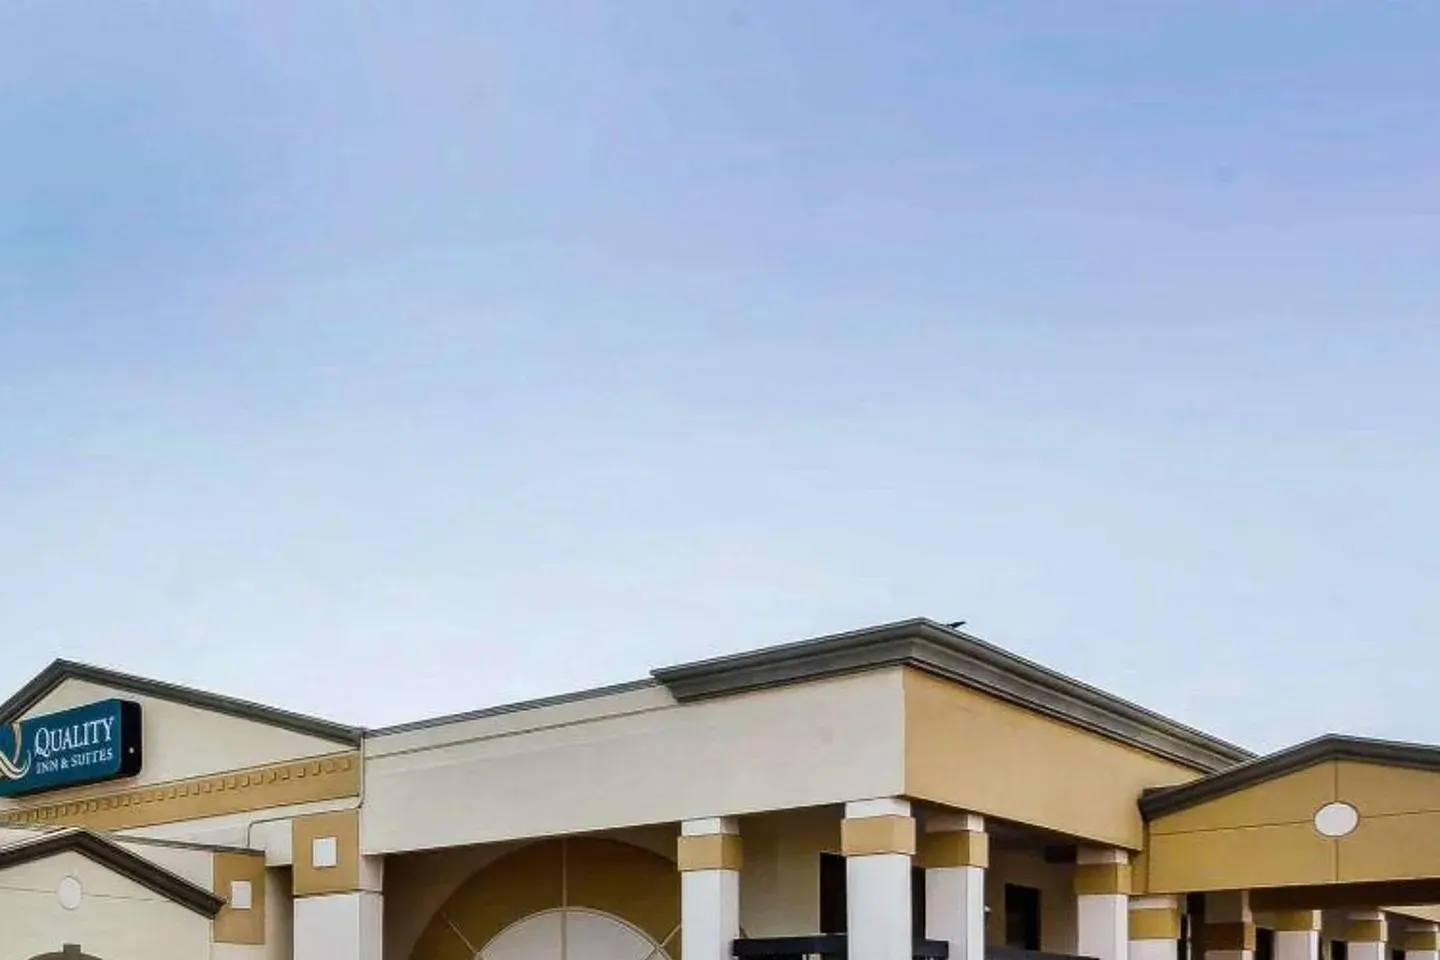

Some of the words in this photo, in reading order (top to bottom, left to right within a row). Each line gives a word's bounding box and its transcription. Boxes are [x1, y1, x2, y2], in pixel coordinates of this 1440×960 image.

[35, 718, 113, 757] QUALITY
[35, 758, 58, 774] INN
[60, 756, 69, 769] &
[71, 747, 113, 767] SUITES
